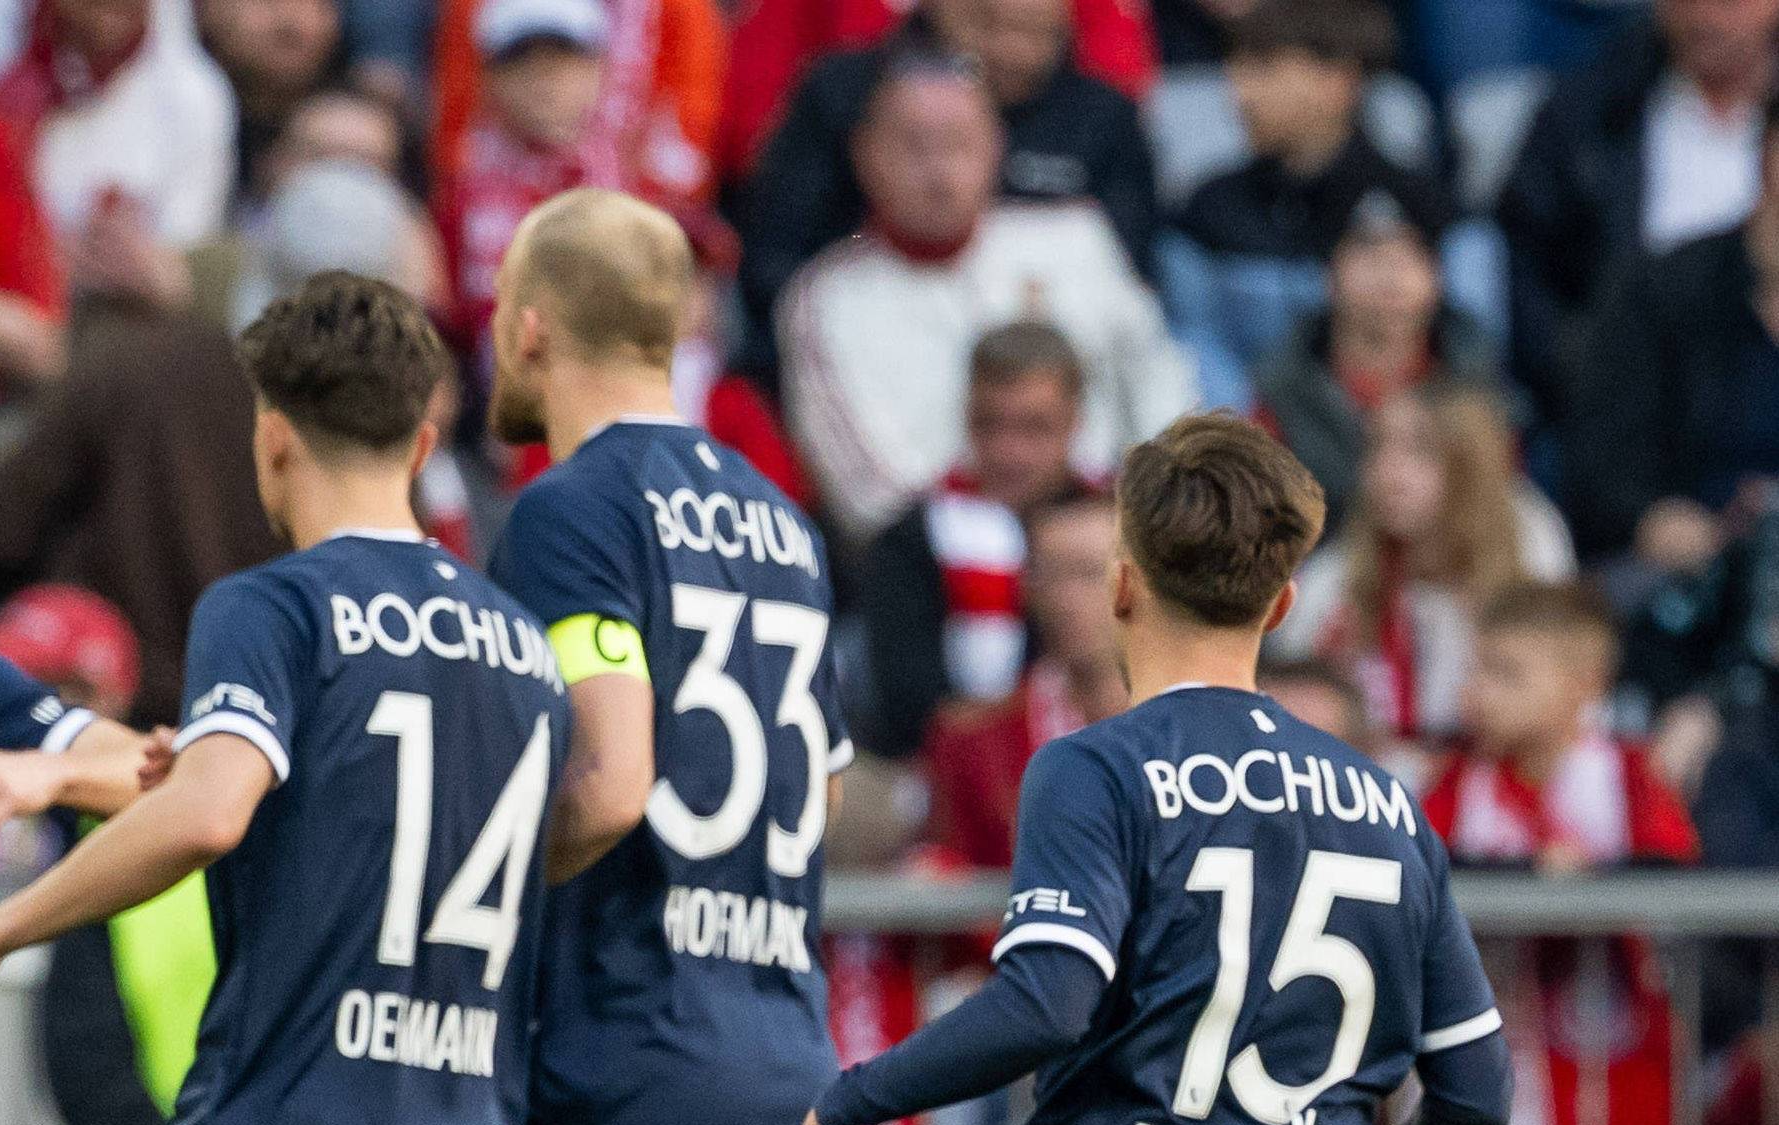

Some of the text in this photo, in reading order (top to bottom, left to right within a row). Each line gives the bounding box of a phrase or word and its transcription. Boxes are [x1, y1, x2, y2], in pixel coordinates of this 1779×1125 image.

[331, 592, 566, 696] BOCHUM
[644, 583, 830, 878] 33
[365, 690, 551, 991] 14
[1143, 749, 1417, 837] BOCHUM
